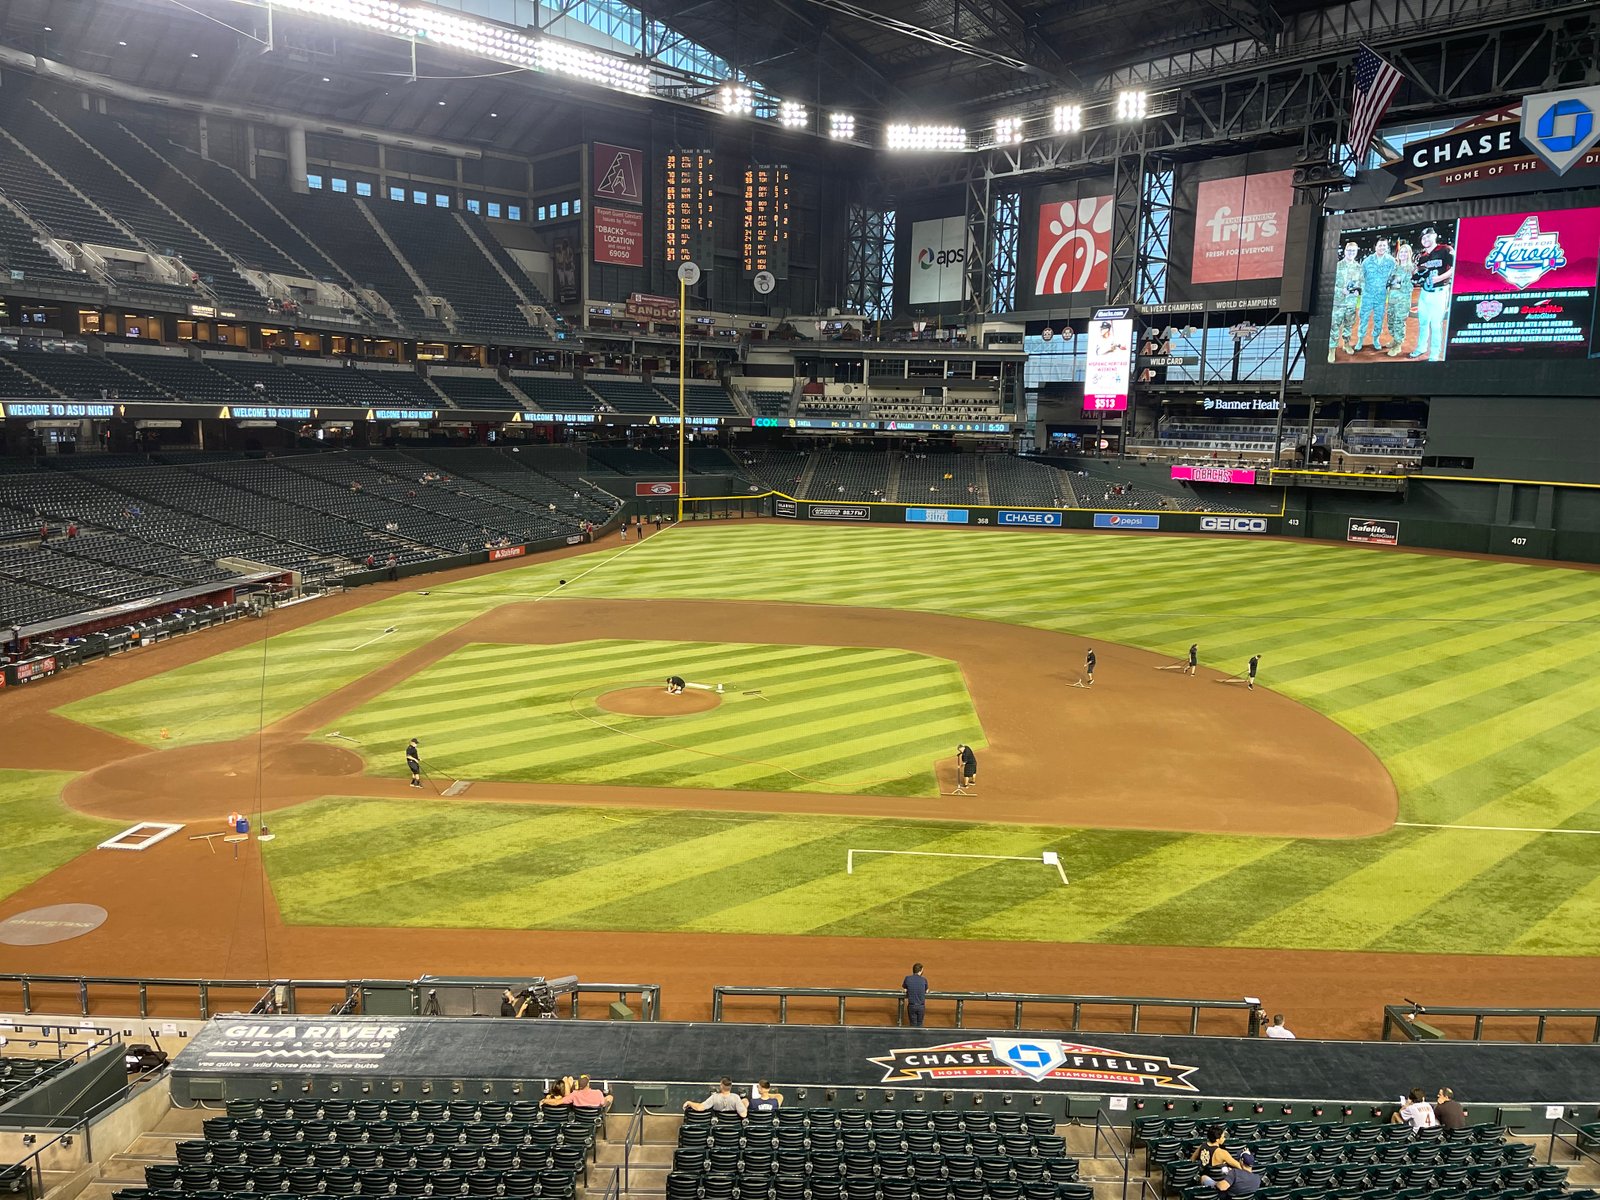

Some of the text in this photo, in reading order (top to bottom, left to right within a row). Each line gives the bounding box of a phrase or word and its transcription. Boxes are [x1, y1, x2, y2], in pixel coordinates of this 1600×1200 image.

[1413, 131, 1512, 168] CHASE
[1445, 169, 1479, 183] HOME
[1489, 166, 1504, 176] OF
[1513, 162, 1537, 172] THE
[604, 235, 635, 245] LOCATION
[609, 249, 630, 259] 69050
[1206, 250, 1225, 258] FRESH
[1241, 246, 1275, 255] EVERYONE
[1490, 241, 1563, 262] Heroes
[936, 248, 964, 268] aps
[1168, 303, 1203, 312] CHAMPIONS
[1238, 299, 1277, 308] CHAMPIONS
[1503, 306, 1519, 314] AND
[1095, 398, 1115, 409] $513
[1215, 399, 1286, 410] Banner Healt
[9, 404, 115, 416] WELCOME TO ASU NIGHT
[233, 408, 311, 418] WELCOME TO ASU NIGHT
[376, 410, 433, 419] WELCOME TO ASU NIGHT
[524, 413, 554, 421] WELCOME
[564, 414, 576, 422] ASU
[577, 414, 595, 422] NIGHT
[659, 416, 681, 424] WELCOM
[756, 418, 778, 427] COX
[1195, 468, 1232, 482] DBACKS
[1005, 514, 1042, 522] CHASE
[1121, 518, 1142, 526] pepsi
[1202, 518, 1265, 531] GEICO
[1351, 524, 1386, 533] Safelite
[1512, 537, 1526, 546] 407
[225, 1026, 398, 1039] GILA RIVER
[905, 1054, 1160, 1072] CHASE FIELD
[1055, 1072, 1135, 1081] DIAMONDBACKS
[1425, 1114, 1431, 1126] 4
